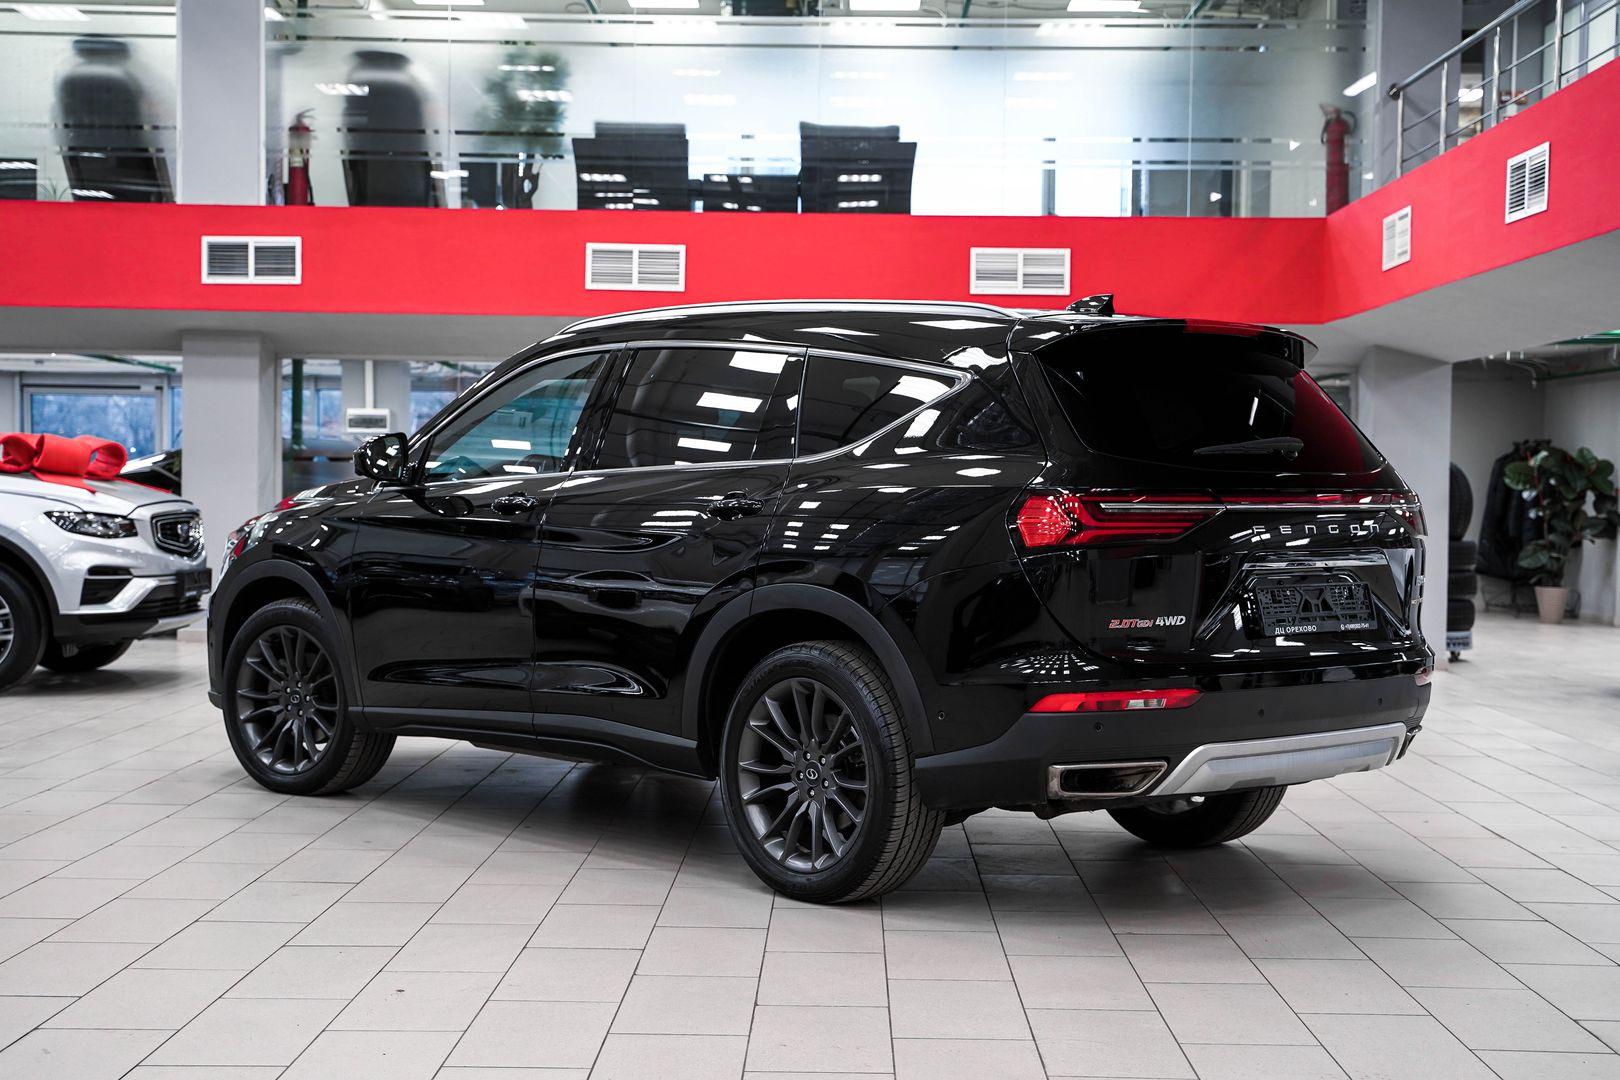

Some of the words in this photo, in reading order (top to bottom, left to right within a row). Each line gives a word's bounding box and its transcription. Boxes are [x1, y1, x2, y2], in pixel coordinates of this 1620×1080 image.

[1155, 615, 1186, 626] 4WD
[1275, 627, 1285, 635] ДЦ
[1286, 625, 1317, 634] ОРЕХОВО
